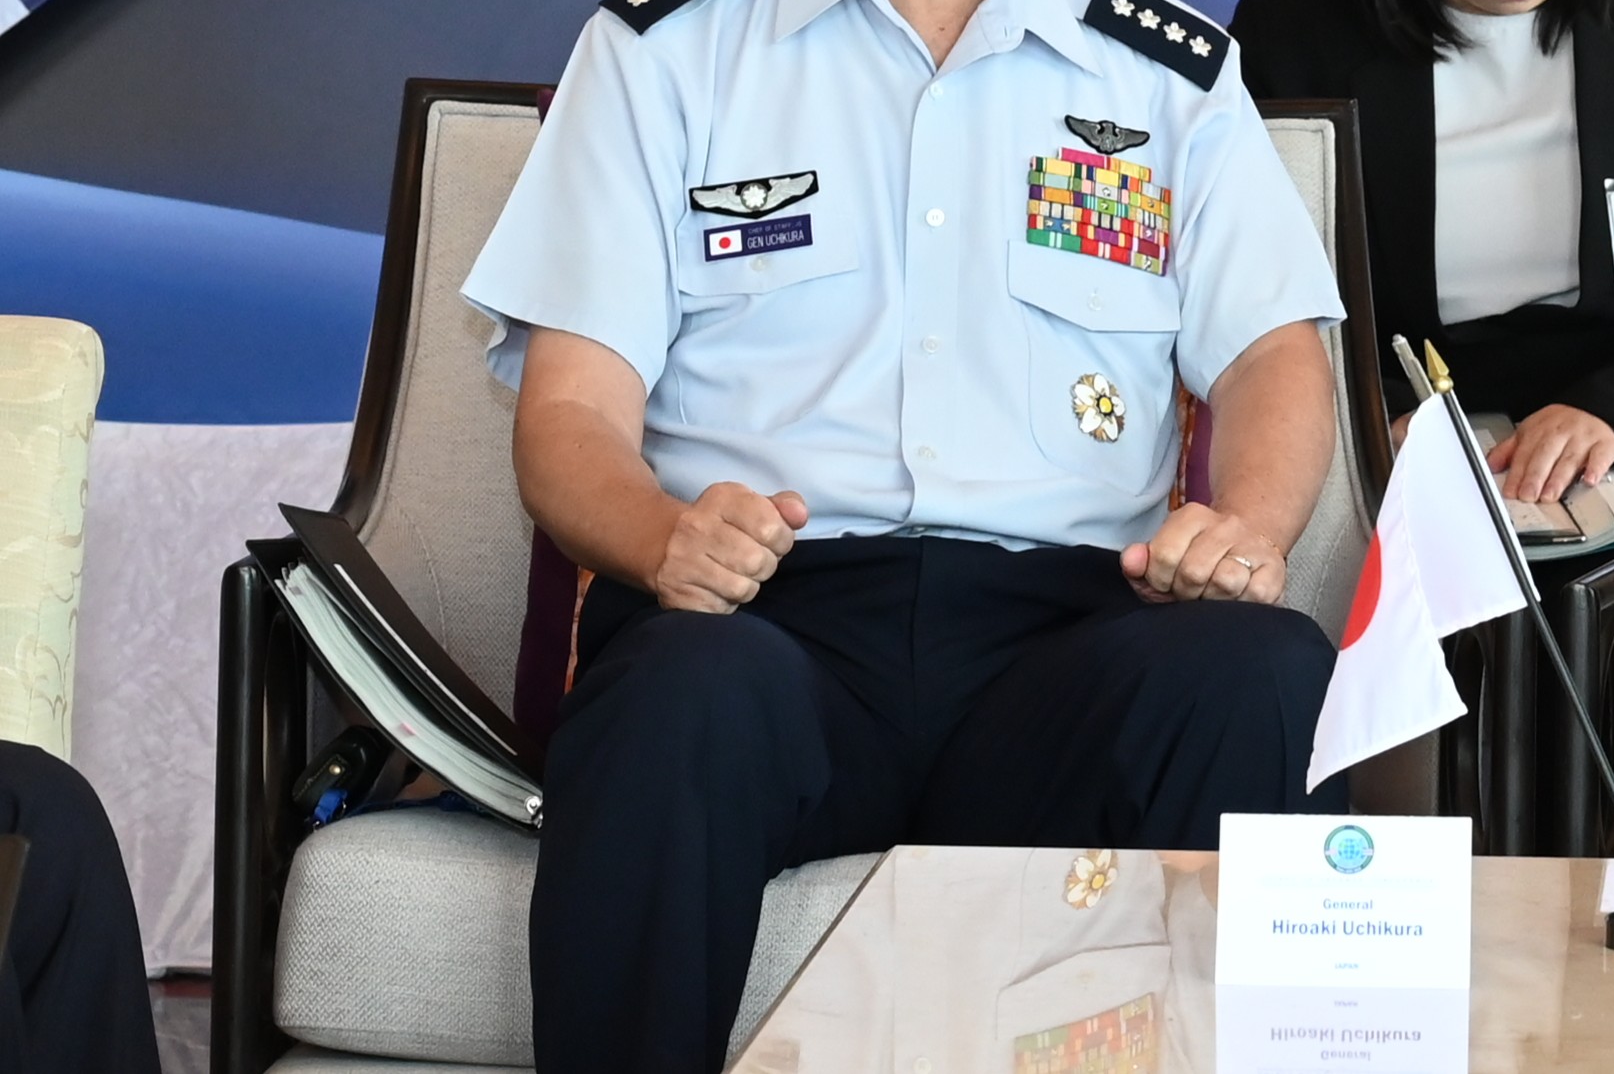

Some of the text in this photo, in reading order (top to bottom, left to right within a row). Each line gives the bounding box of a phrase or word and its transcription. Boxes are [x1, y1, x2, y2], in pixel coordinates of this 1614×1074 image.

[747, 230, 805, 249] GEN UCHIKURA
[1322, 898, 1374, 911] General
[1272, 919, 1424, 937] Hiroaki Uchikura
